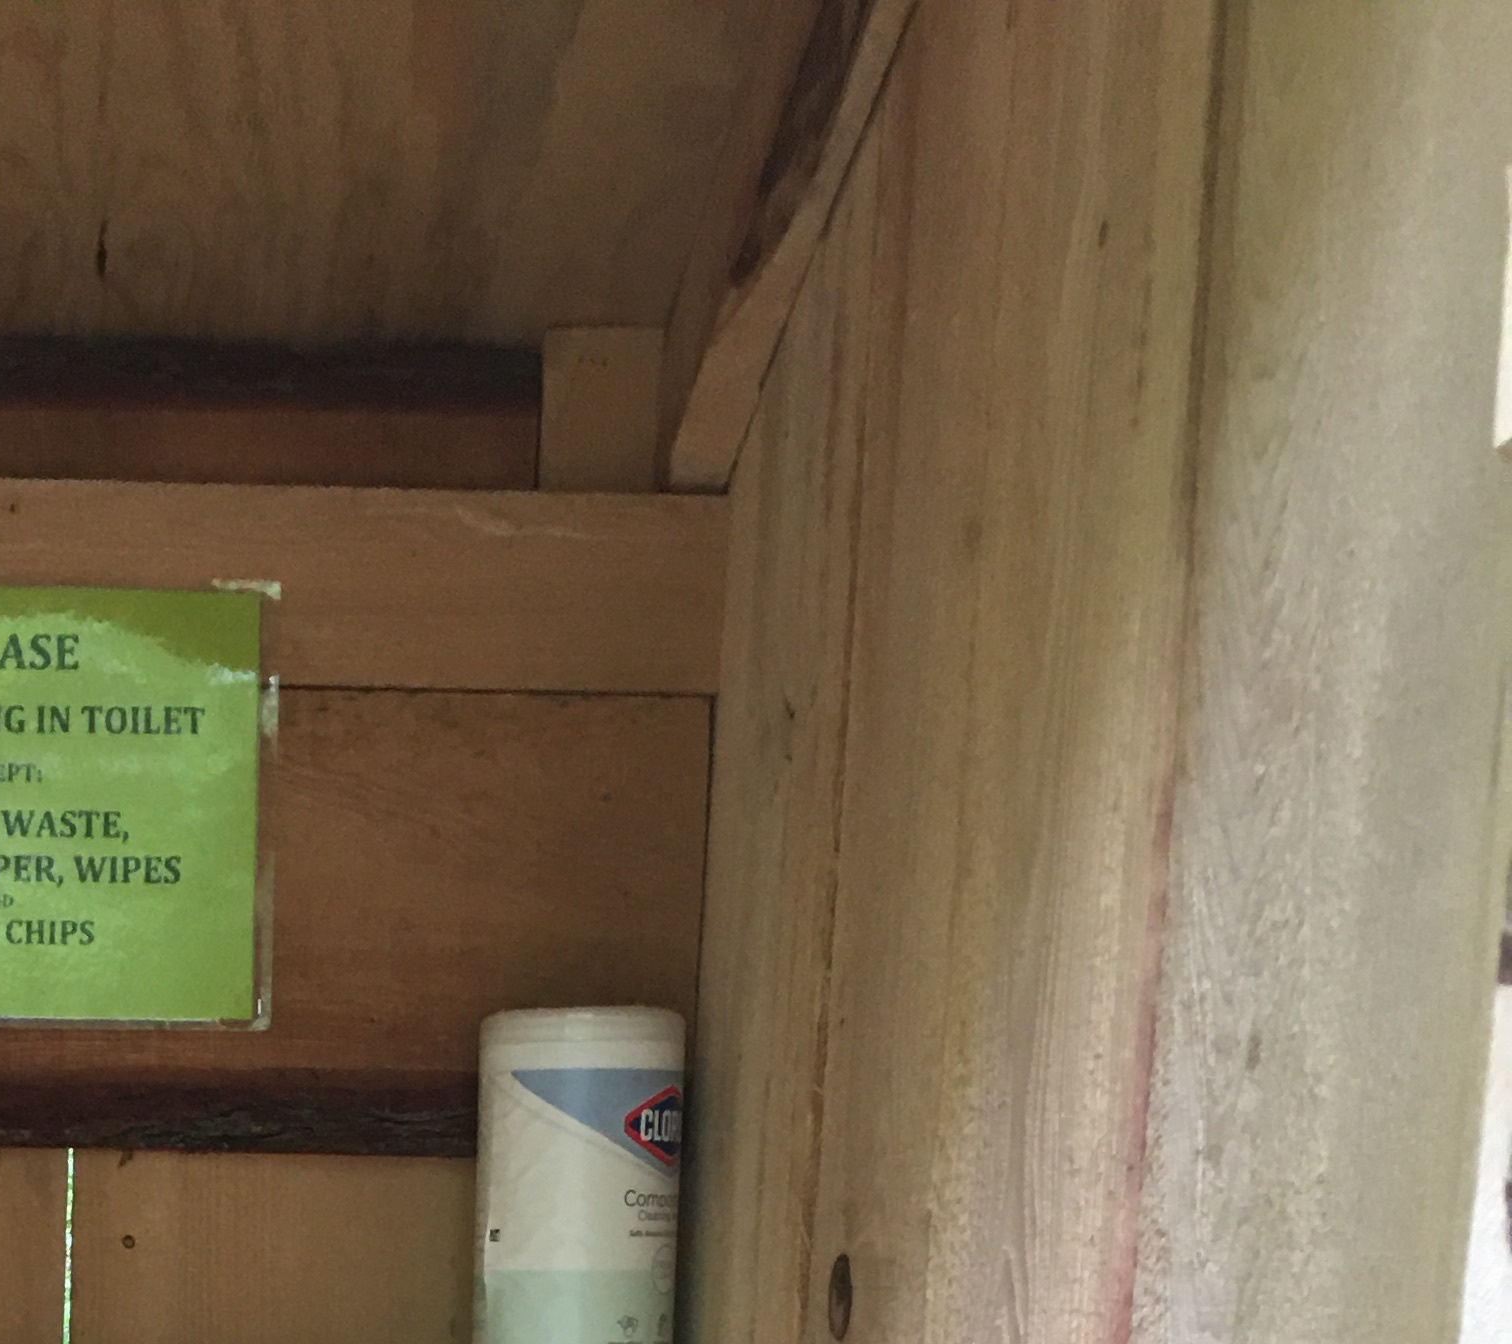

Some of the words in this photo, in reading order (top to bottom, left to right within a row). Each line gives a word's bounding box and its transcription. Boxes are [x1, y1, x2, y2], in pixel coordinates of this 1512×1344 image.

[37, 705, 70, 734] IN
[81, 705, 205, 735] TOILET
[1, 810, 129, 843] WASTE,
[75, 856, 181, 884] WIPES
[5, 920, 95, 945] CHIPS
